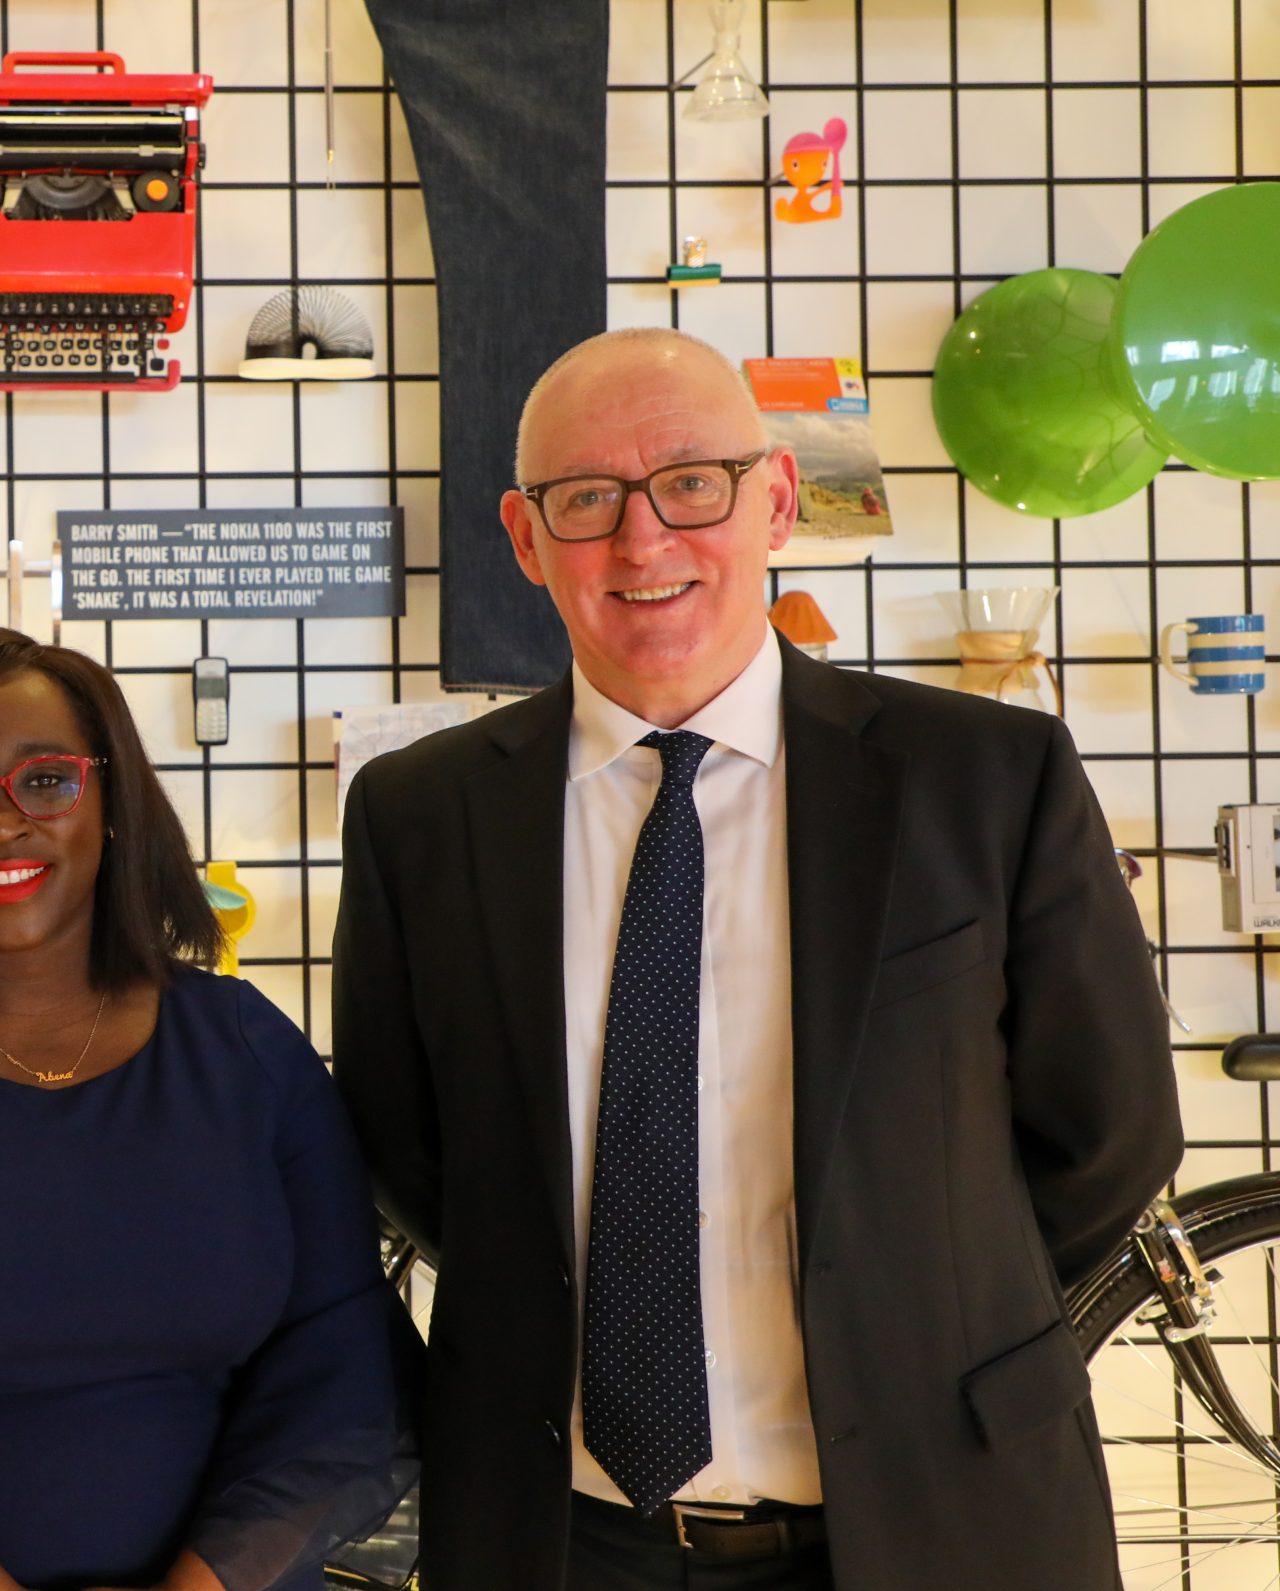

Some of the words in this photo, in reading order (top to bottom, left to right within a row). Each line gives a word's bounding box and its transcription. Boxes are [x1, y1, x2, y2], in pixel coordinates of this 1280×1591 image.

[71, 524, 114, 542] BARRY
[116, 523, 158, 541] SMITH
[220, 522, 260, 540] NOKIA
[263, 522, 293, 540] 1100
[296, 522, 325, 539] WAS
[327, 521, 352, 539] THE
[356, 521, 392, 539] FIRST
[72, 547, 121, 564] MOBILE
[125, 546, 169, 564] PHONE
[172, 546, 204, 563] THAT
[207, 545, 267, 563] ALLOWED
[271, 544, 289, 562] US
[291, 544, 308, 562] TO
[311, 544, 349, 562] GAME
[352, 543, 371, 561] ON
[71, 569, 97, 587] THE
[99, 569, 123, 587] GO.
[126, 569, 151, 586] THE
[154, 568, 191, 586] FIRST
[193, 568, 226, 586] TIME
[229, 568, 236, 585] I
[239, 567, 272, 585] EVER
[275, 566, 324, 584] PLAYED
[326, 566, 352, 584] THE
[355, 566, 392, 584] GAME
[133, 591, 146, 609] IT
[148, 591, 178, 609] WAS
[180, 590, 190, 608] A
[193, 590, 231, 608] TOTAL
